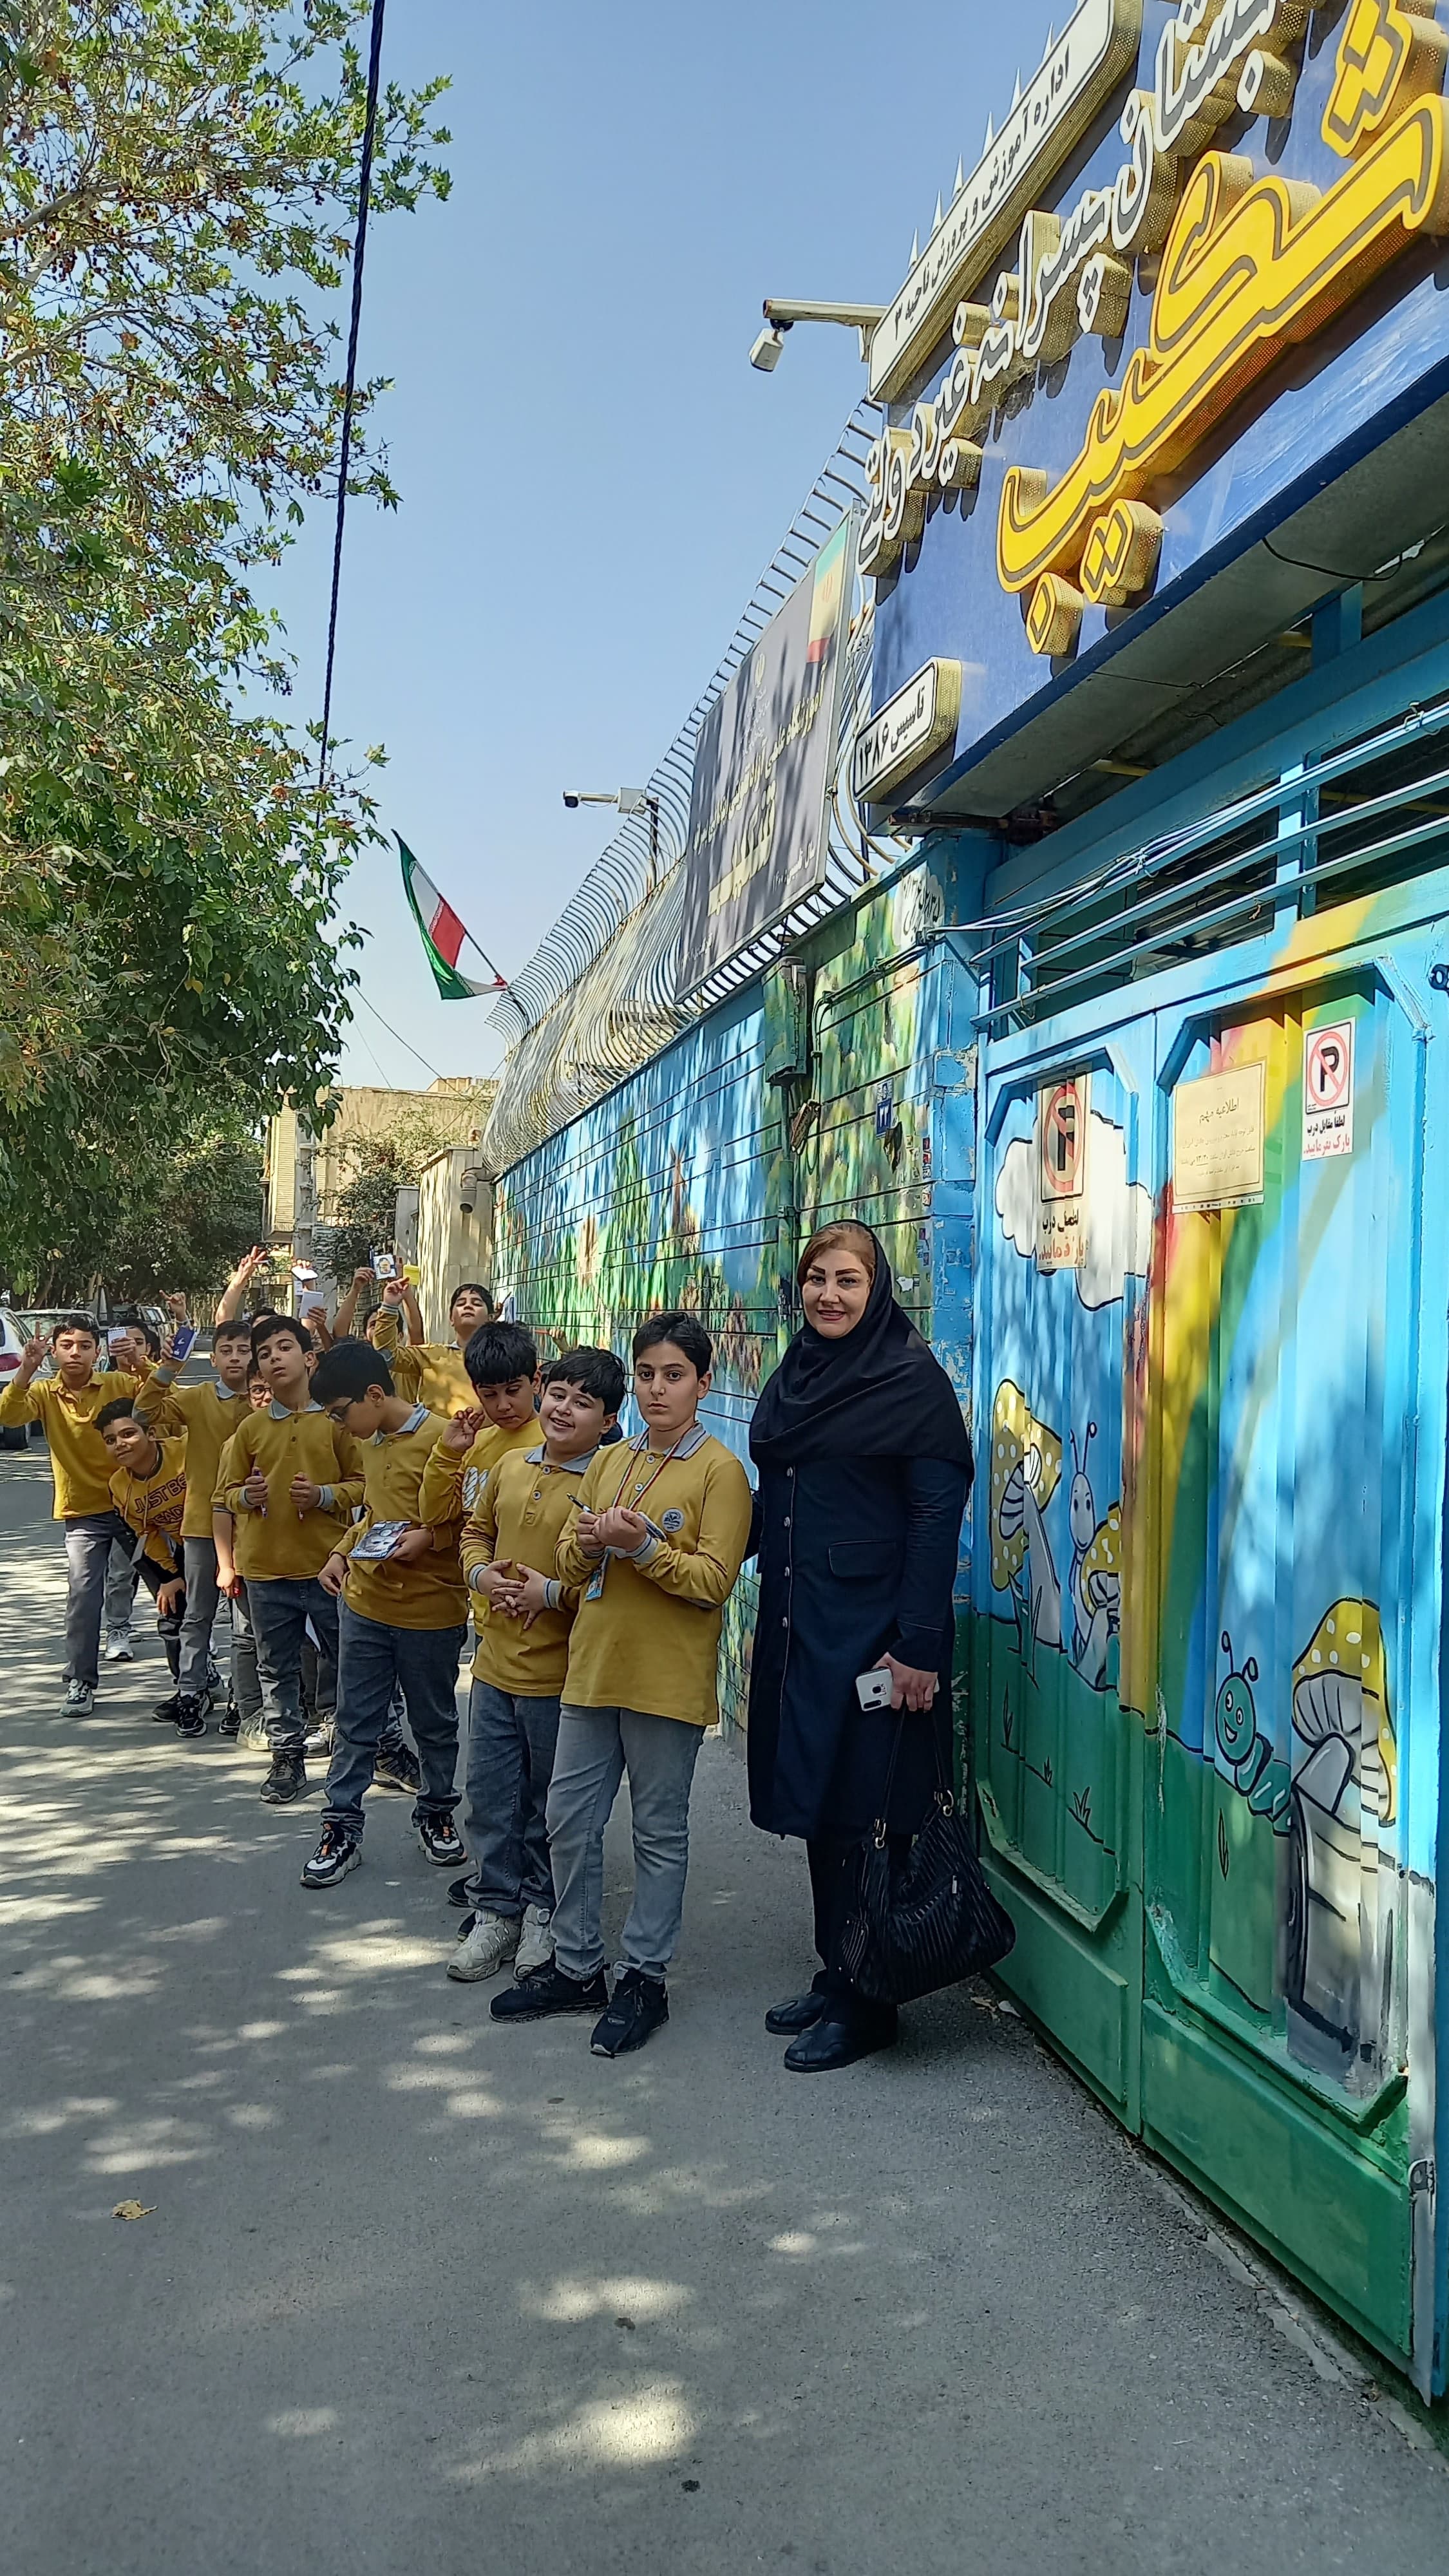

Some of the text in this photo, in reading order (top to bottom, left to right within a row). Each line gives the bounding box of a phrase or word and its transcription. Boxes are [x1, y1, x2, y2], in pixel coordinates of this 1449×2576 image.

[1034, 43, 1070, 129] اداره
[981, 99, 1031, 211] آموزش
[970, 196, 979, 230] و
[932, 207, 968, 289] پرورش
[905, 261, 929, 325] ناحیه
[971, 185, 1115, 405] پسرانه
[860, 721, 889, 782] ۱۳۸۶
[1216, 1097, 1239, 1118] اطلاعیه
[1307, 1123, 1318, 1137] درب
[1320, 1118, 1333, 1134] مقابل
[1332, 1133, 1350, 1152] پارک
[135, 1485, 169, 1514] JUST
